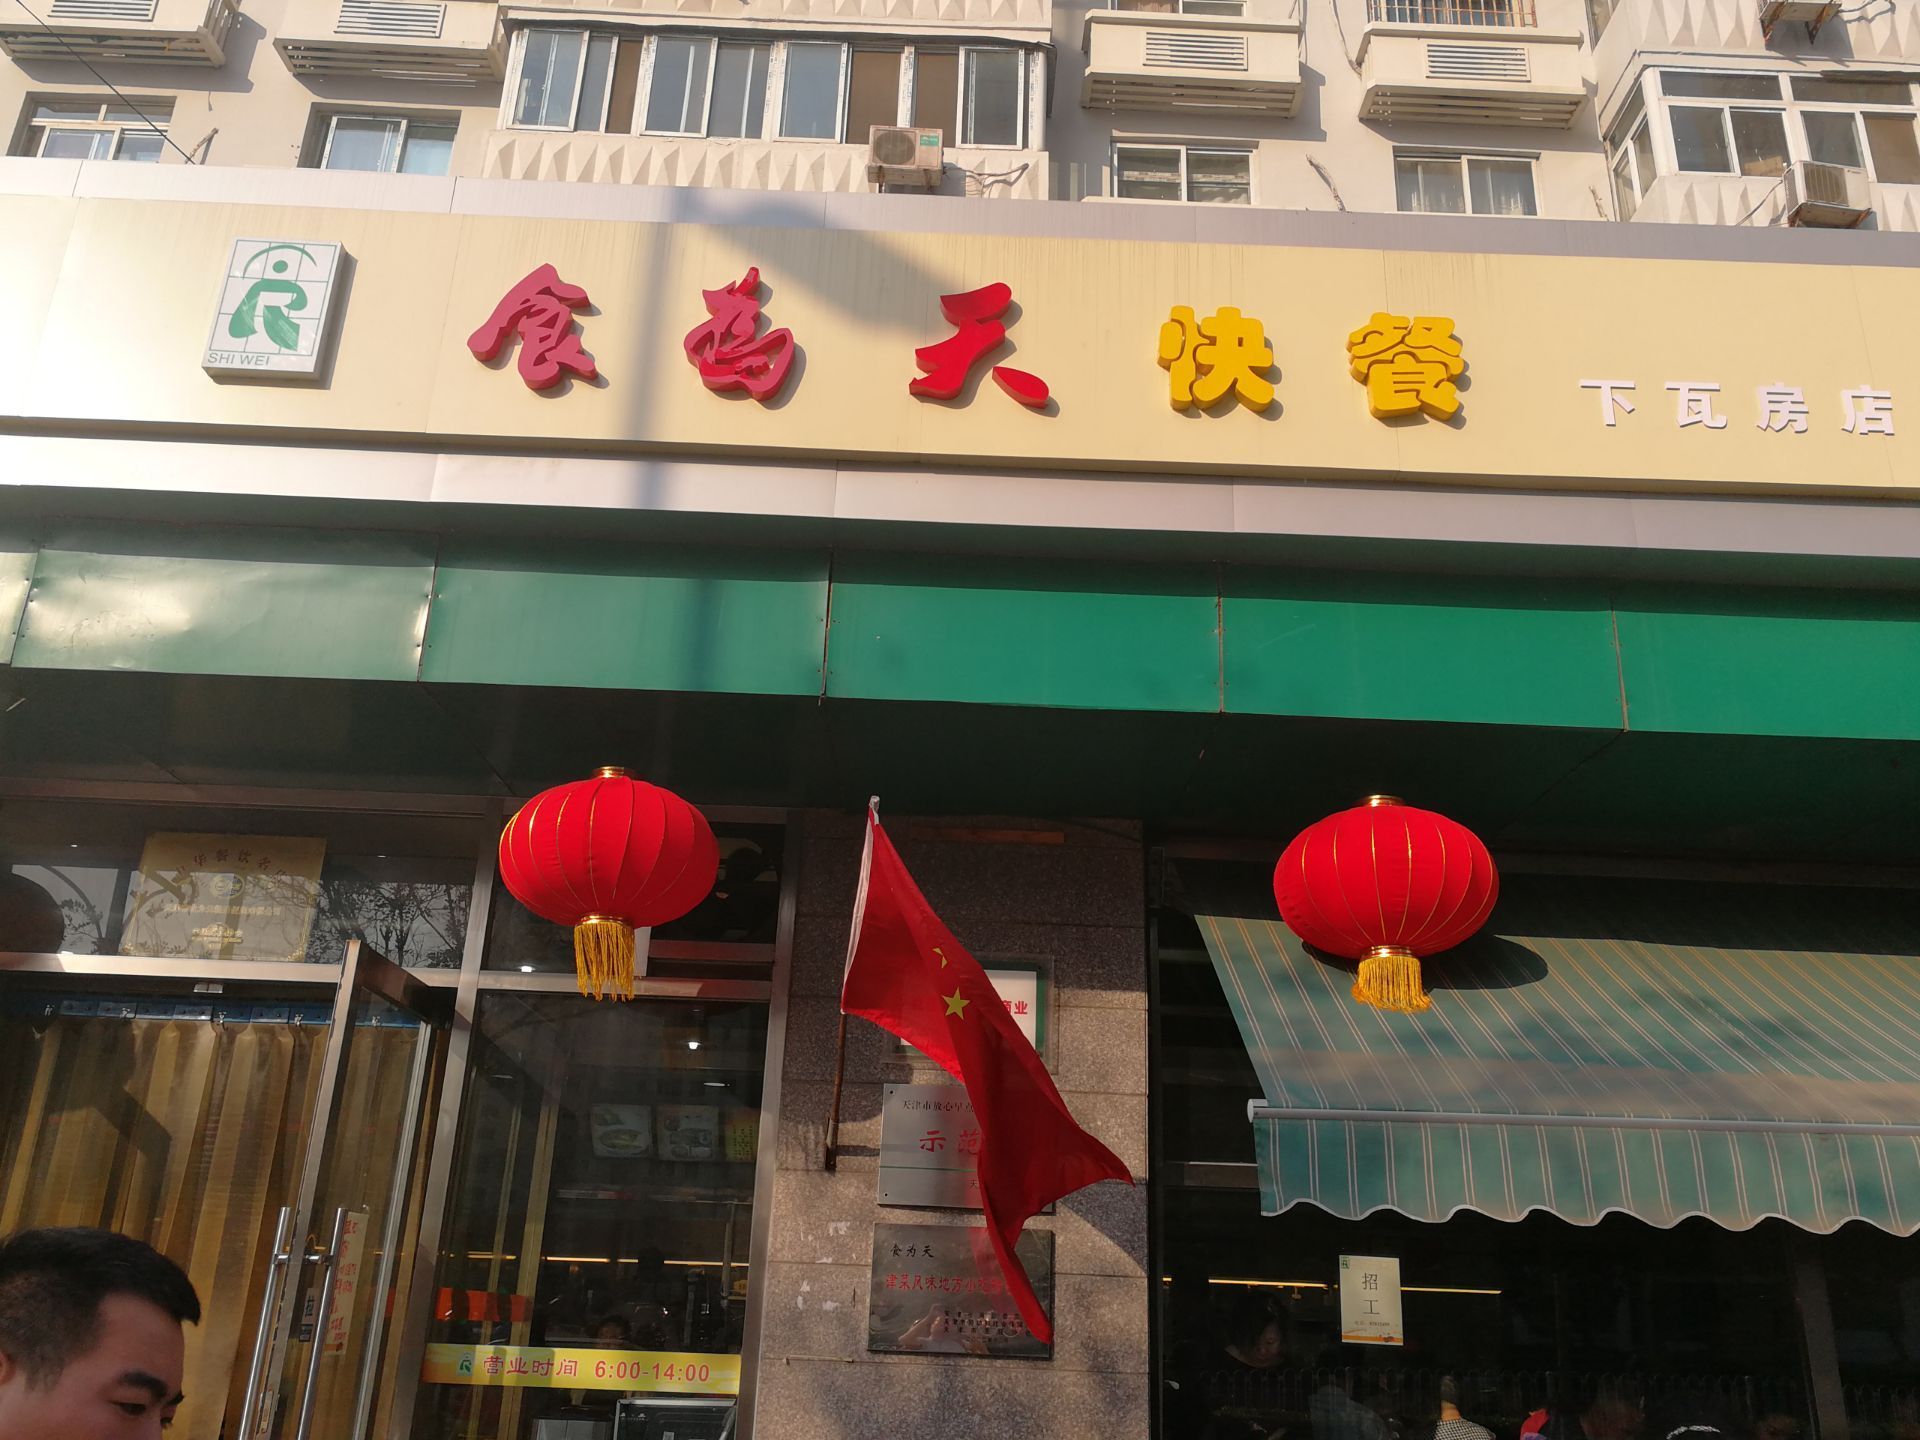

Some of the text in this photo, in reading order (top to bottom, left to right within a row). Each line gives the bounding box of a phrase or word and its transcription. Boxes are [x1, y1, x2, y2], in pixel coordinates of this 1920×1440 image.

[207, 352, 270, 366] SHI WEI
[1578, 379, 1896, 436] 下瓦房店
[890, 1243, 935, 1258] 食为天
[1361, 1272, 1380, 1315] 招工
[483, 1355, 711, 1383] 营业时间 6:00-14:00
